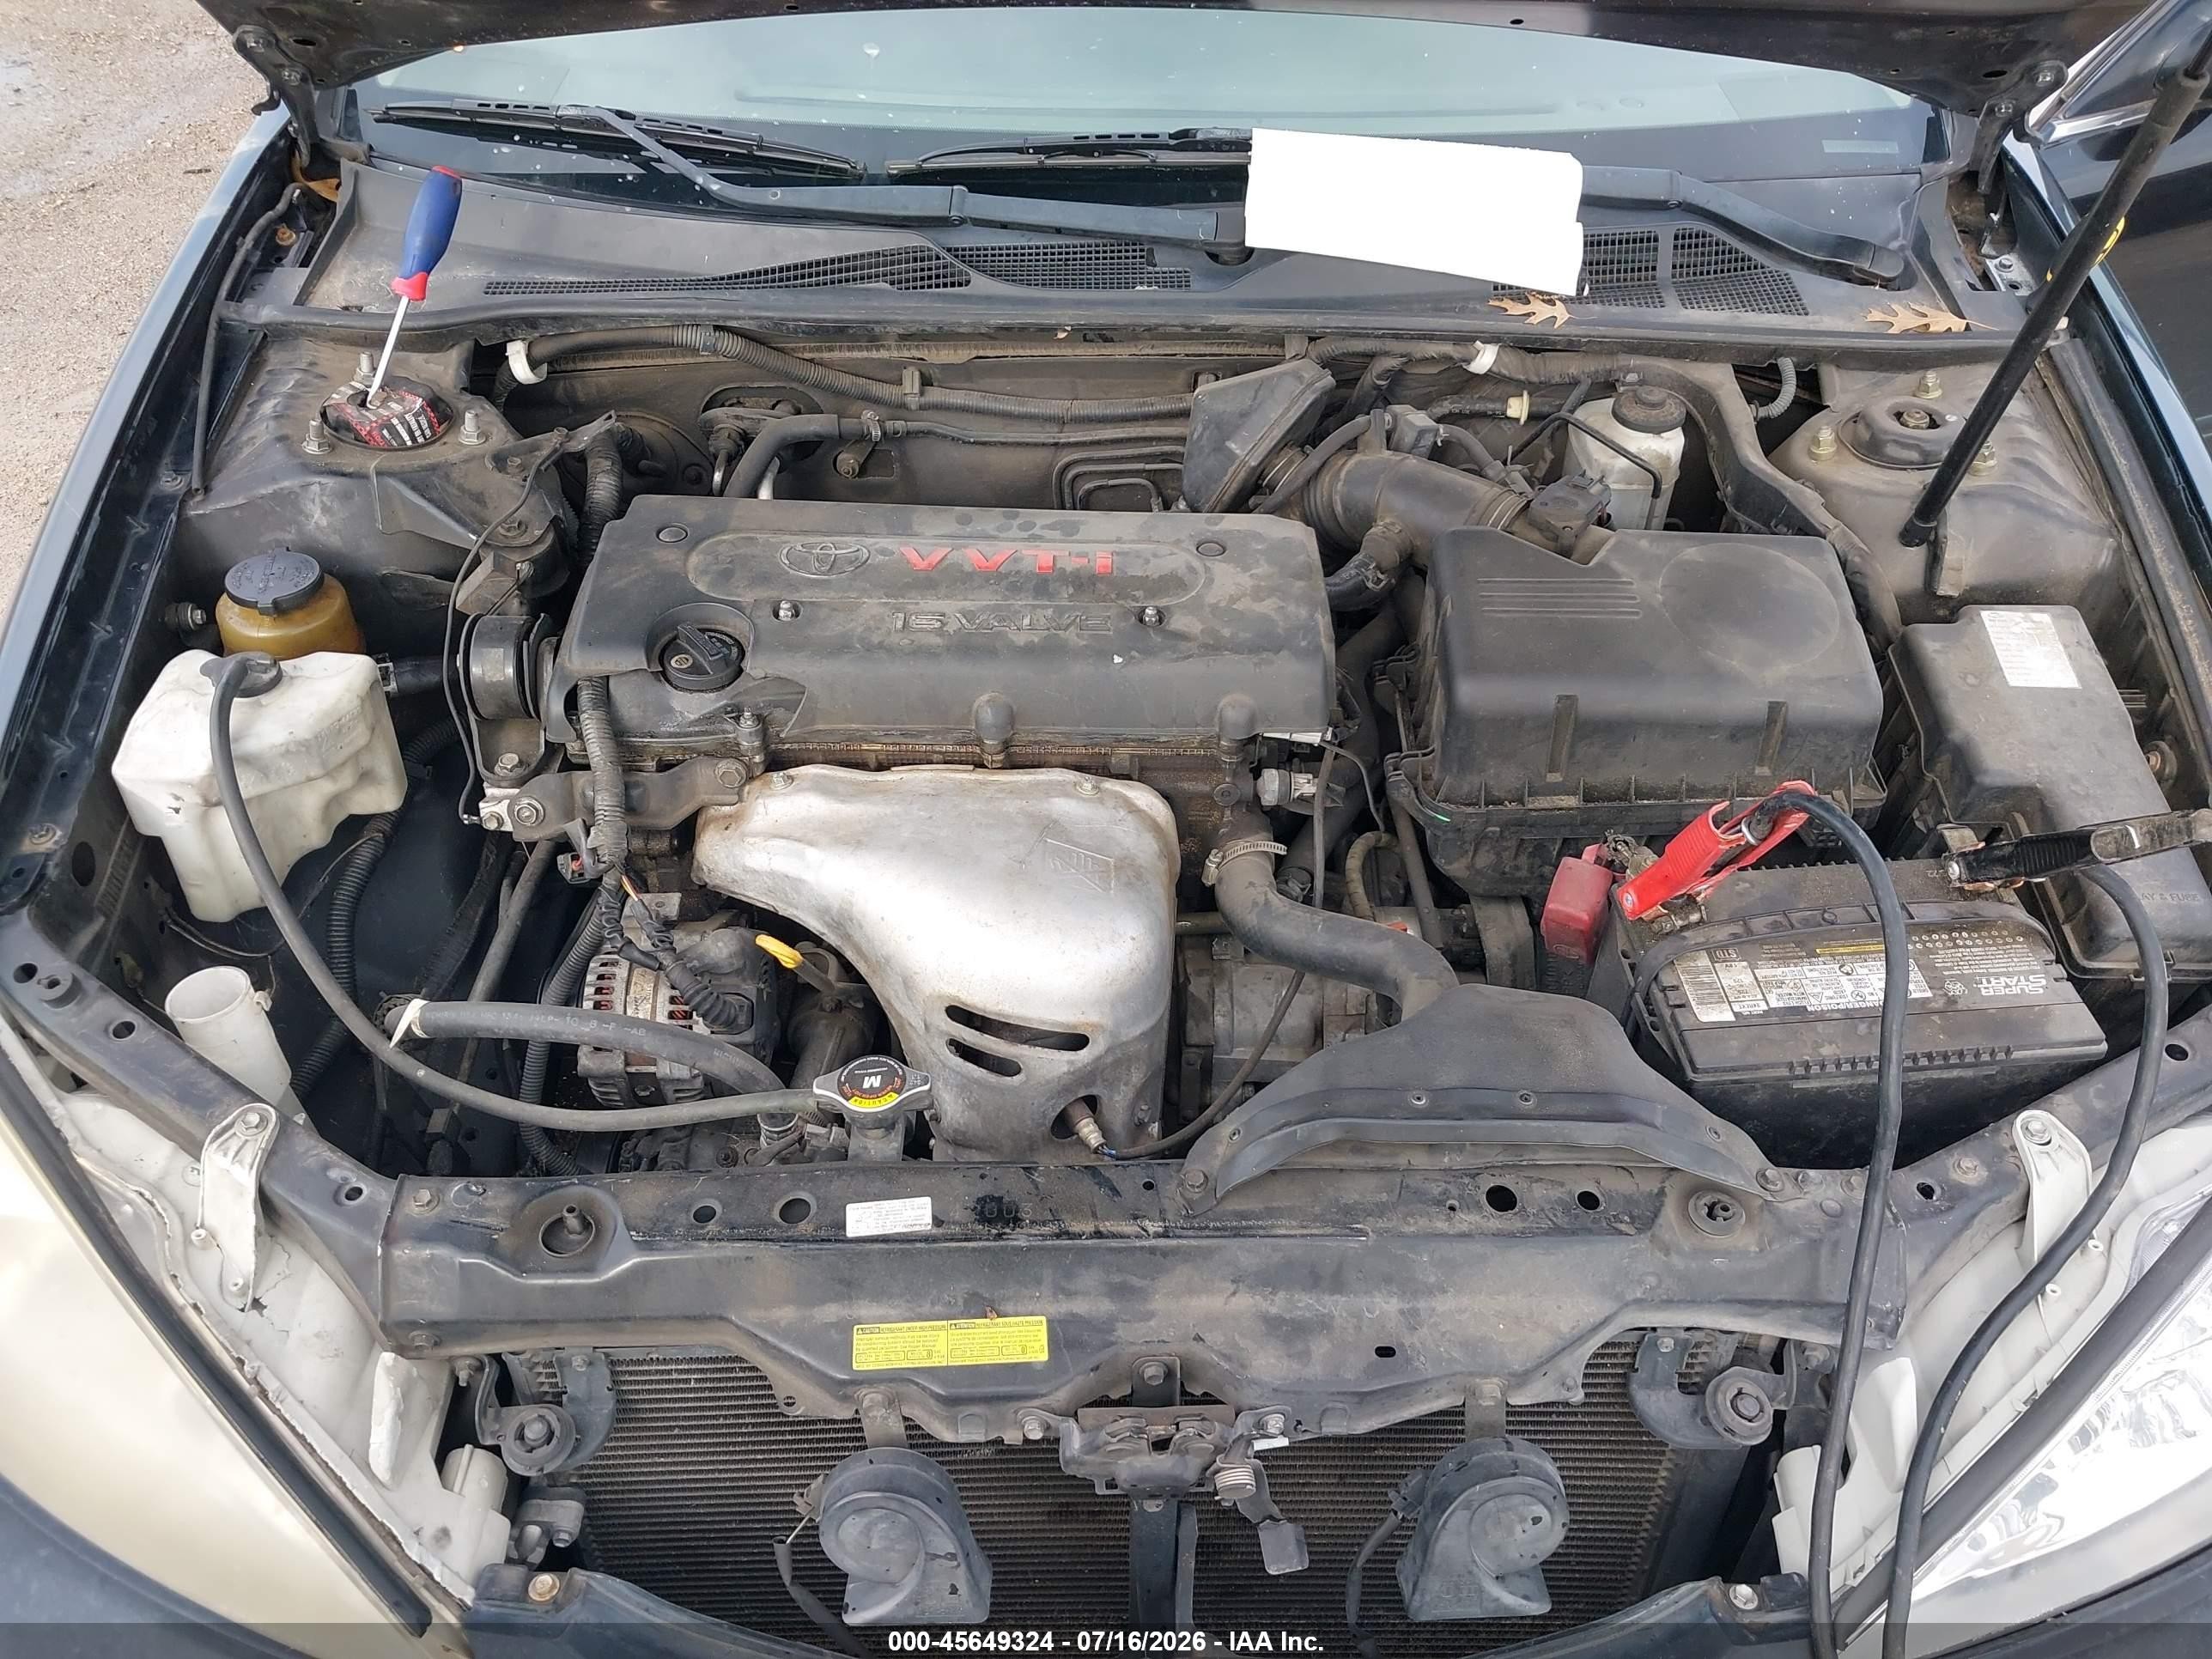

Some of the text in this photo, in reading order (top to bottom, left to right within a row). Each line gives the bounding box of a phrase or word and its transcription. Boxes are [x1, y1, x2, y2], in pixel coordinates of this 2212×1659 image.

[899, 546, 1114, 574] VVT-i
[892, 611, 1113, 633] 16 VALVE
[2169, 893, 2199, 902] FUSE
[1975, 975, 2047, 988] START
[1980, 986, 2044, 996] SUPER
